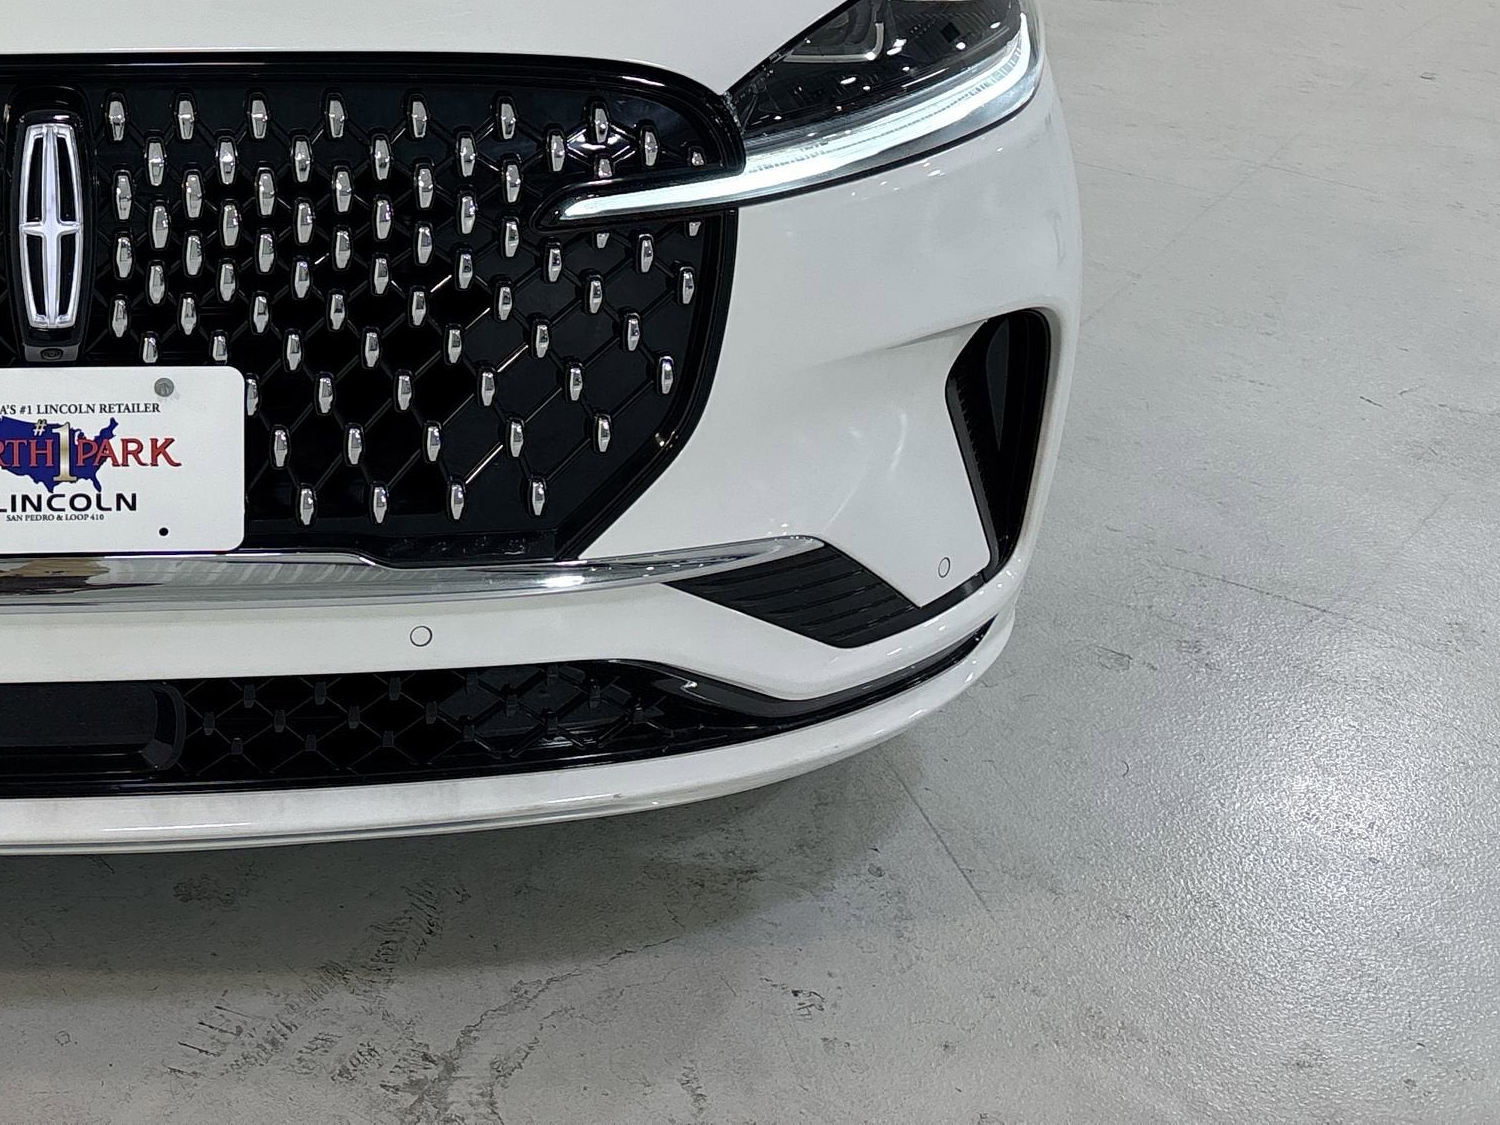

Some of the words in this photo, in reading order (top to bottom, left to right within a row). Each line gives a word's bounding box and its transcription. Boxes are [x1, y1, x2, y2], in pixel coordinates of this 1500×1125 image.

[19, 404, 32, 415] #1
[36, 403, 96, 415] LINCOLN
[99, 402, 161, 414] RETAILER
[76, 437, 182, 468] PARK
[6, 514, 23, 522] SAN
[25, 514, 55, 522] PEDRO
[65, 513, 90, 521] LOOP
[90, 513, 105, 521] 410
